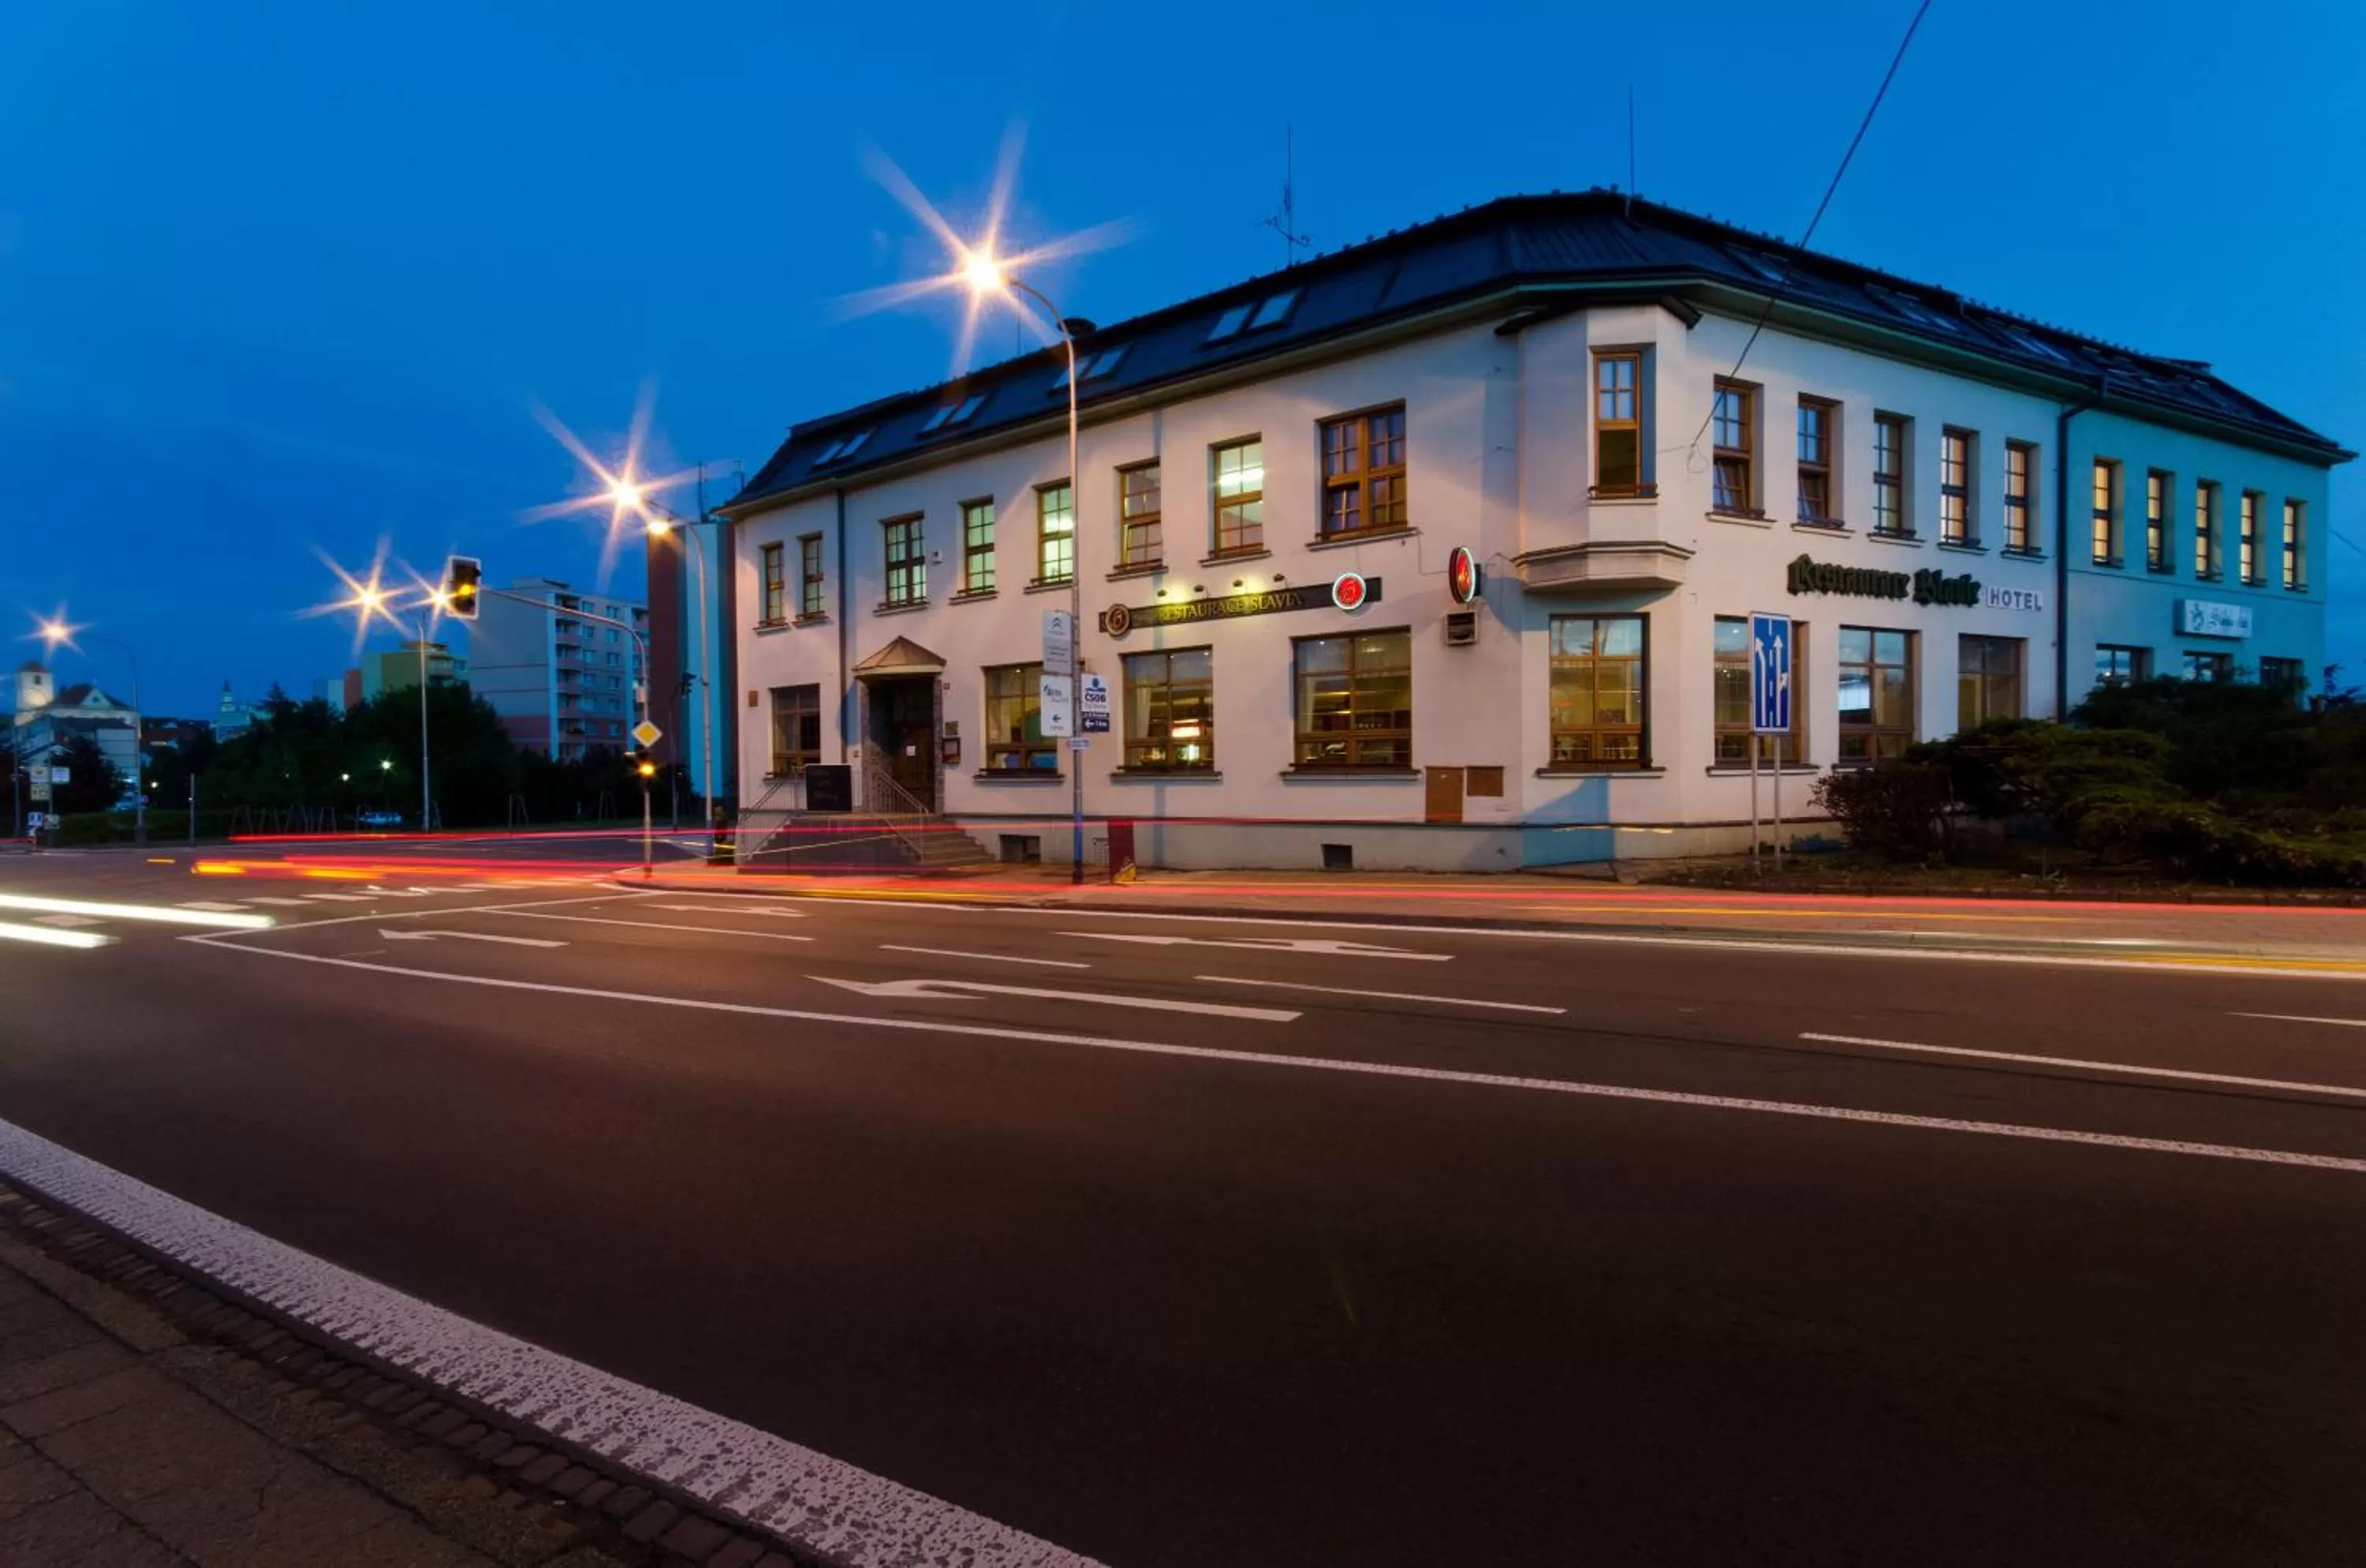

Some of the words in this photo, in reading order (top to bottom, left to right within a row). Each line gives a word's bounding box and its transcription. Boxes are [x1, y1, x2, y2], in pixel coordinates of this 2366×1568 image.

[1158, 597, 1244, 622] RESTAURACE
[1249, 592, 1304, 612] SLAVIA
[1990, 588, 2043, 611] HOTEL
